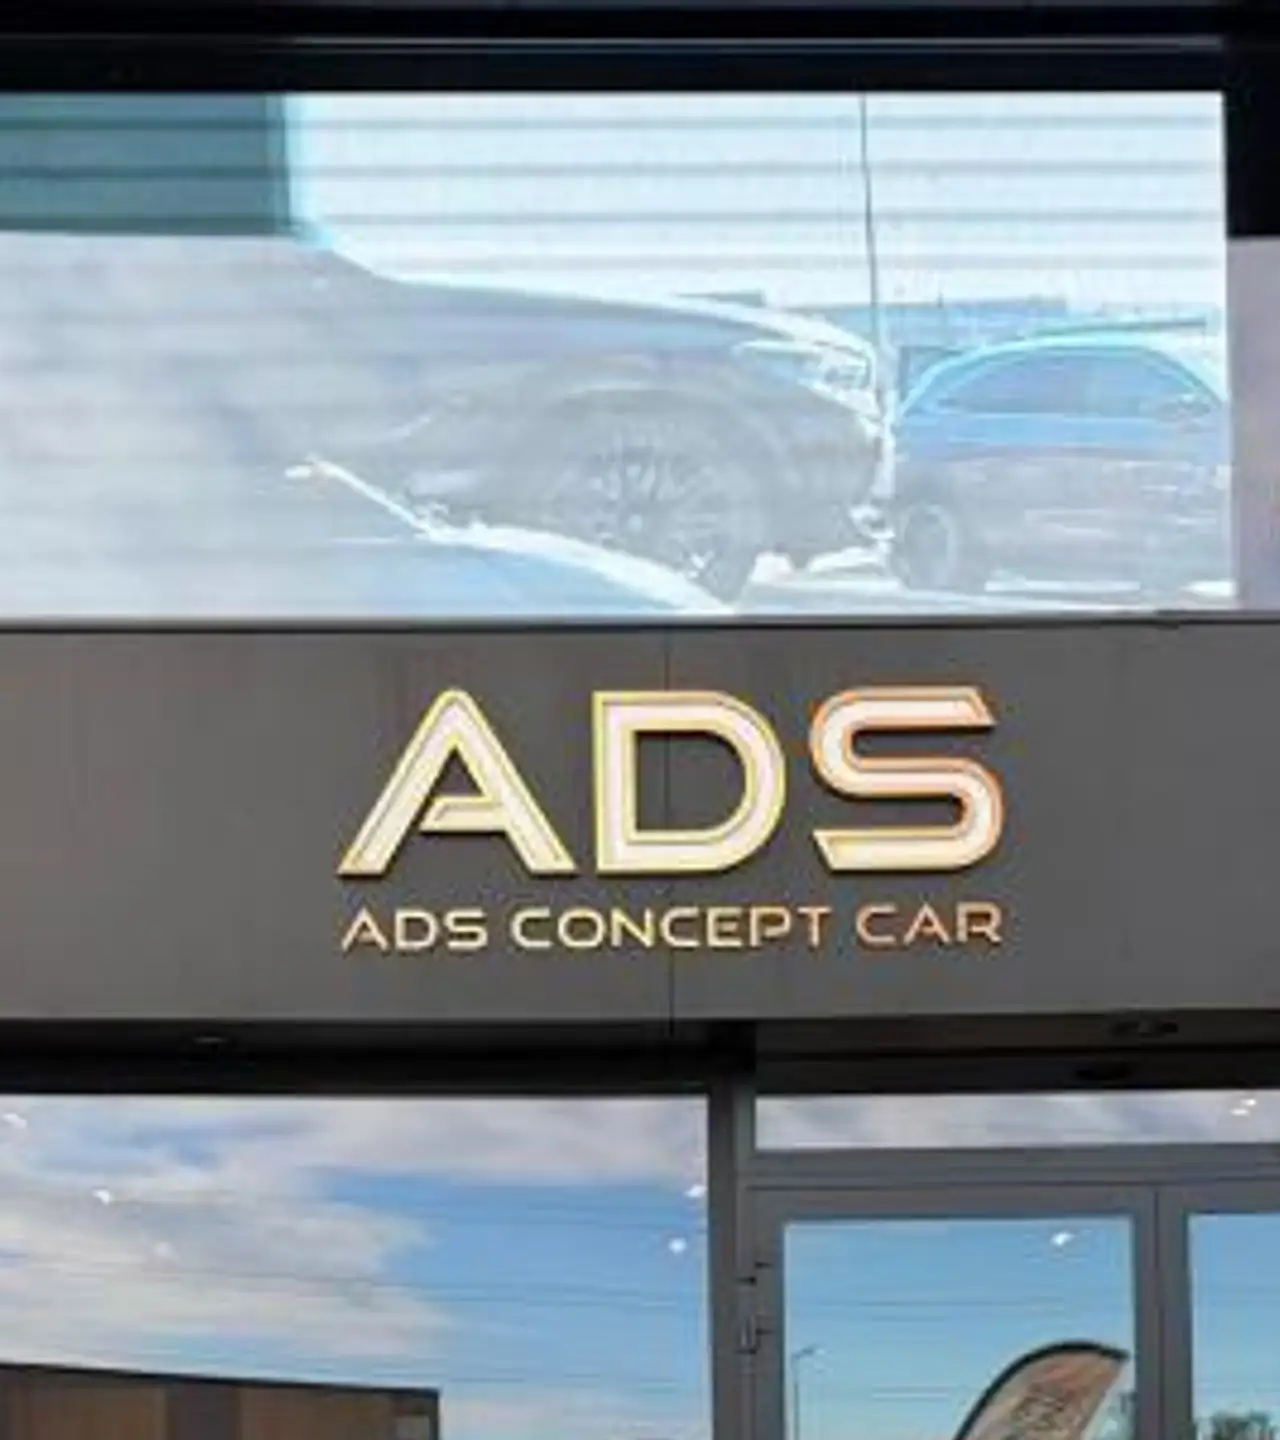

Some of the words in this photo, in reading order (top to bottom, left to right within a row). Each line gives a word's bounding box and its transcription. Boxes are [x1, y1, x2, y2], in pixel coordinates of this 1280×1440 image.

[337, 687, 1004, 874] ADS
[341, 907, 489, 950] ADS
[511, 905, 832, 949] CONCEPT
[855, 901, 1004, 945] CAR
